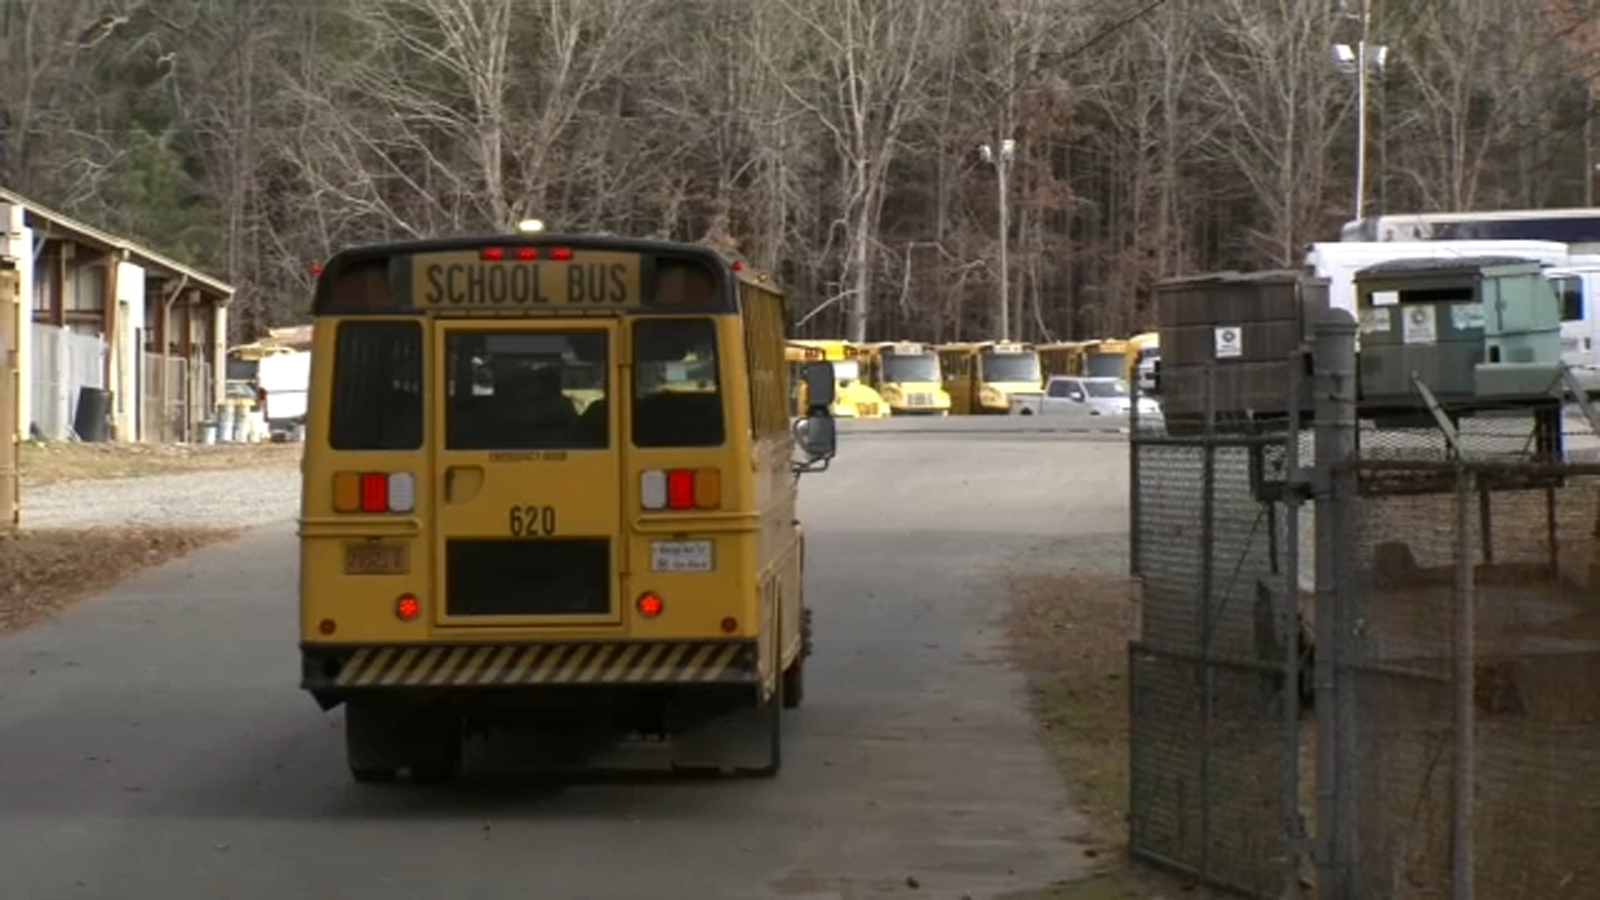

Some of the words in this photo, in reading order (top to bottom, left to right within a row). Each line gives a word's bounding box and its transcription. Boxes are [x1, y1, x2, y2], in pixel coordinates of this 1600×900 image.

[426, 264, 549, 304] SCHOOL
[567, 263, 627, 303] BUS
[509, 505, 556, 537] 620
